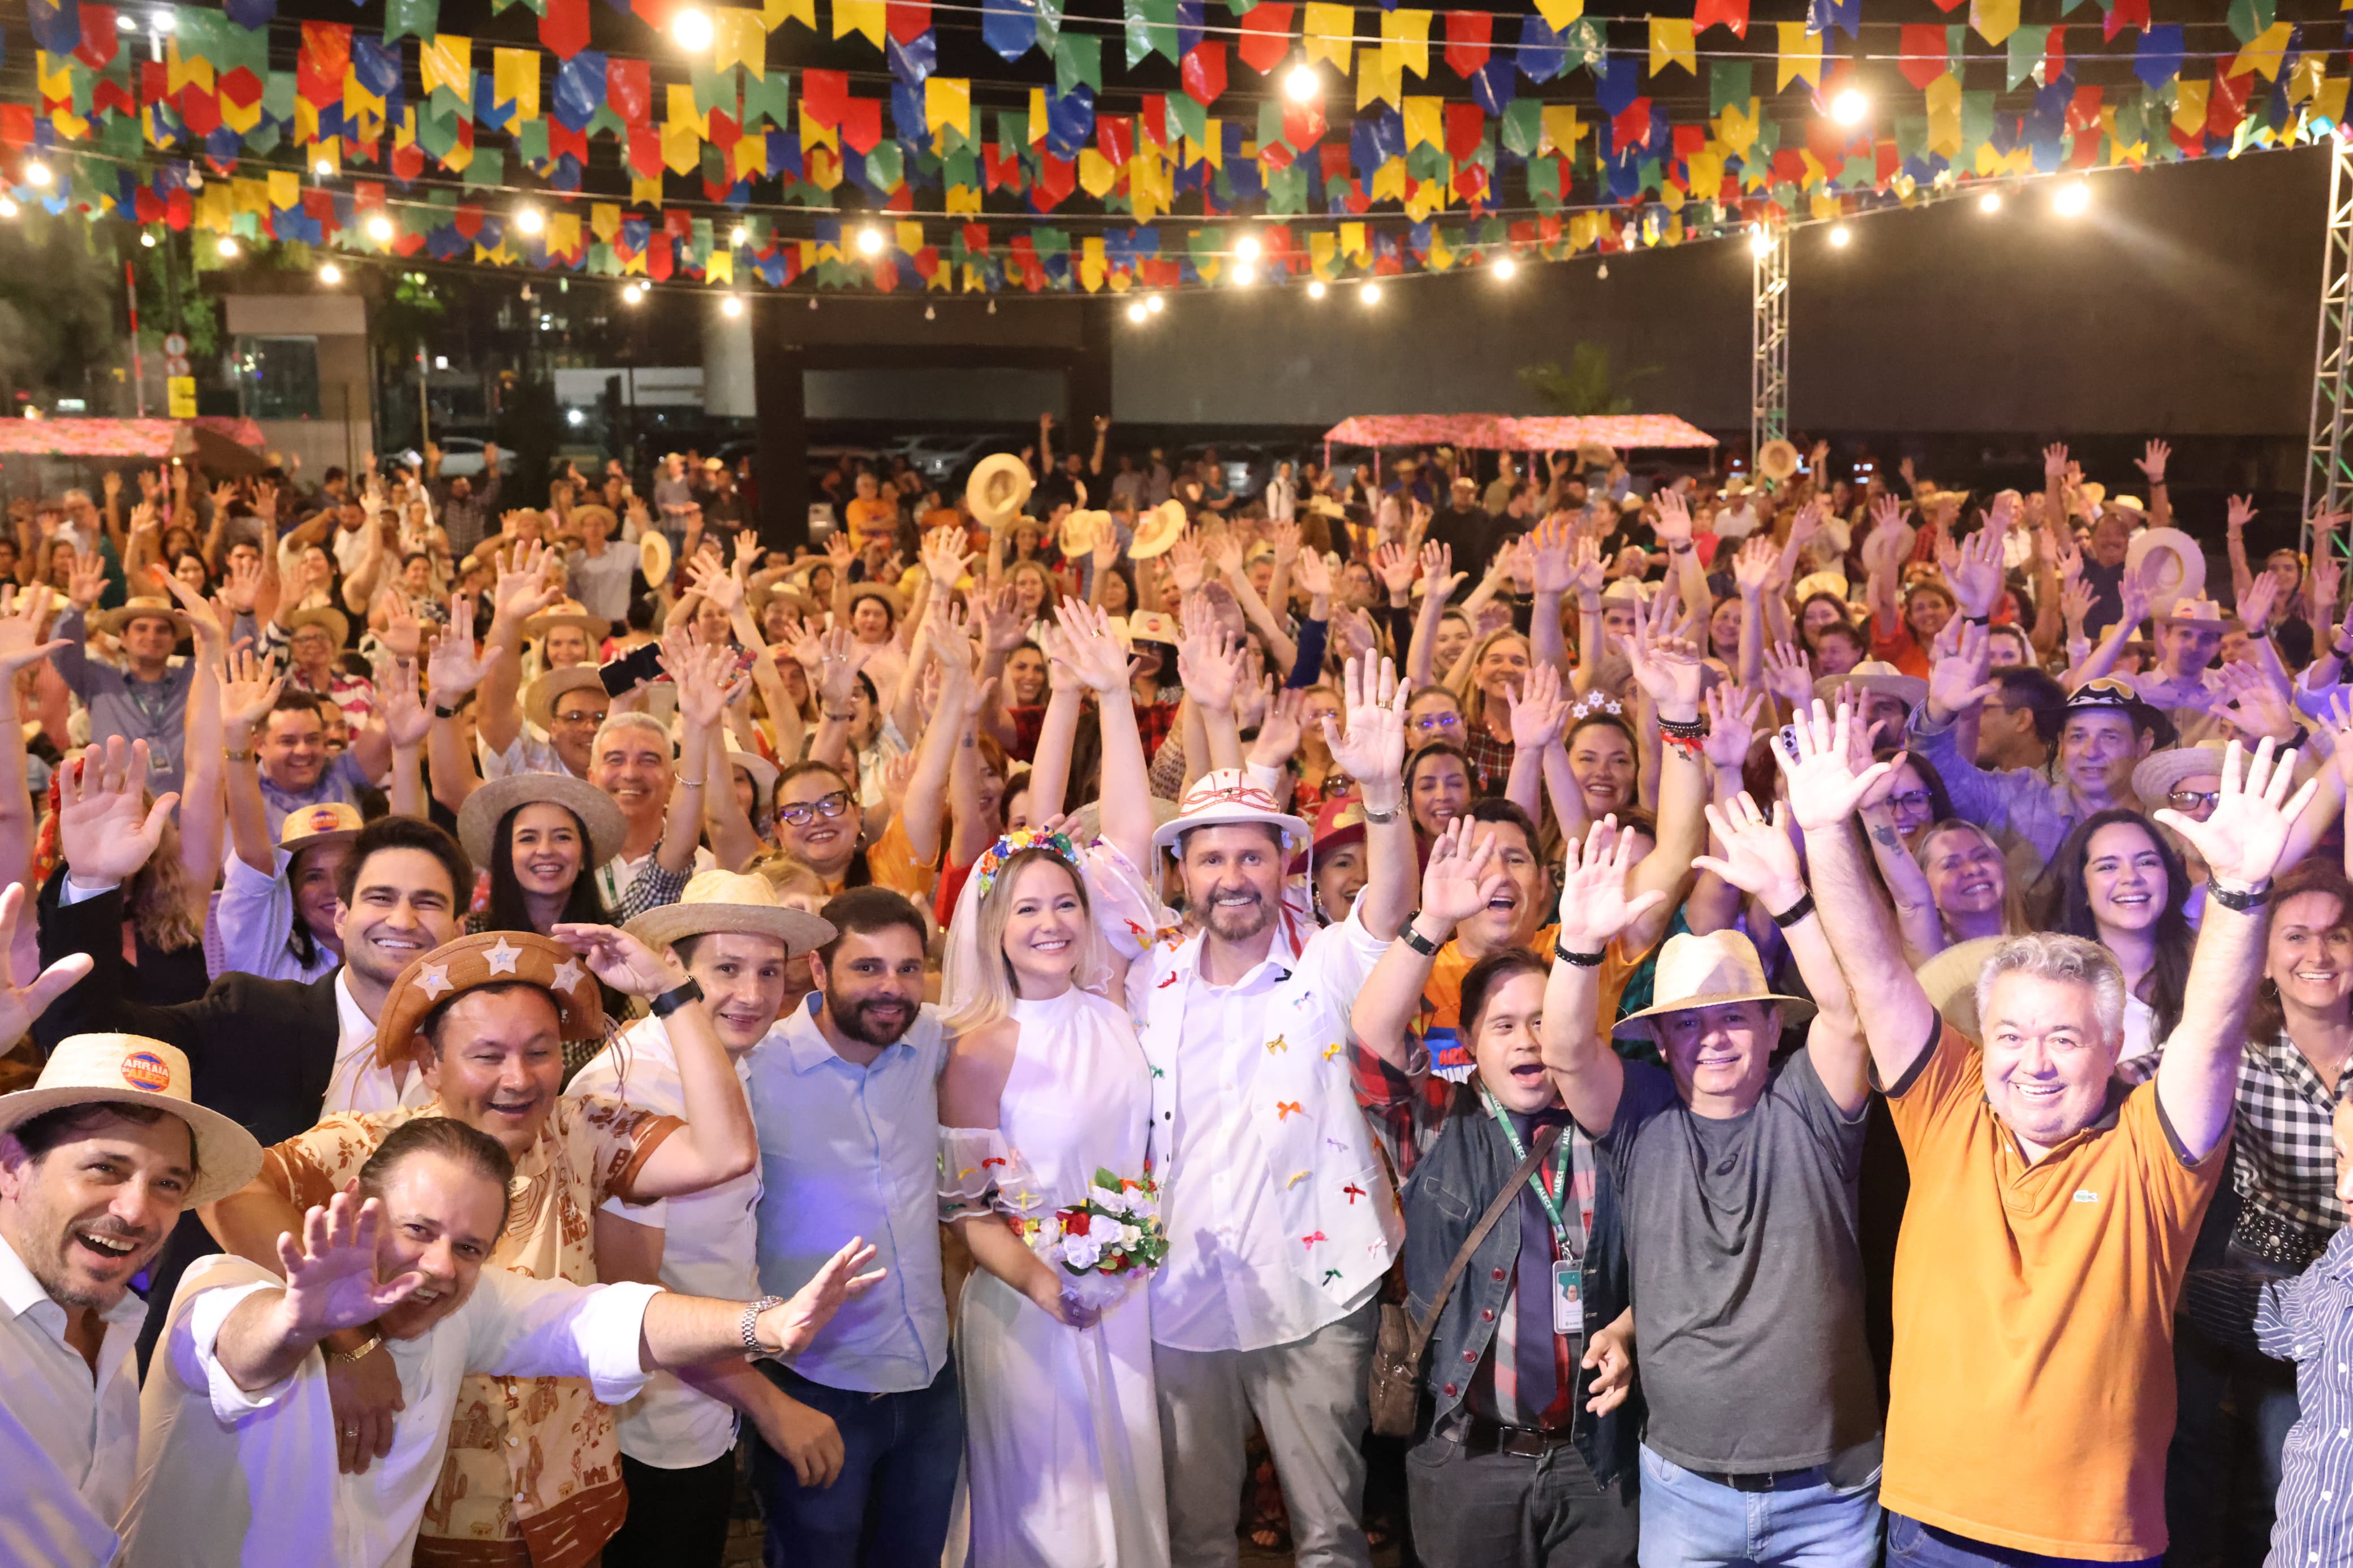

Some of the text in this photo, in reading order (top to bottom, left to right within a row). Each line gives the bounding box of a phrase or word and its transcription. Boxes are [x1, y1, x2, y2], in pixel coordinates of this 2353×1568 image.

[1512, 1137, 1527, 1160] ALECE
[1554, 1170, 1564, 1193] ALECE
[1537, 1187, 1553, 1210] ALECE
